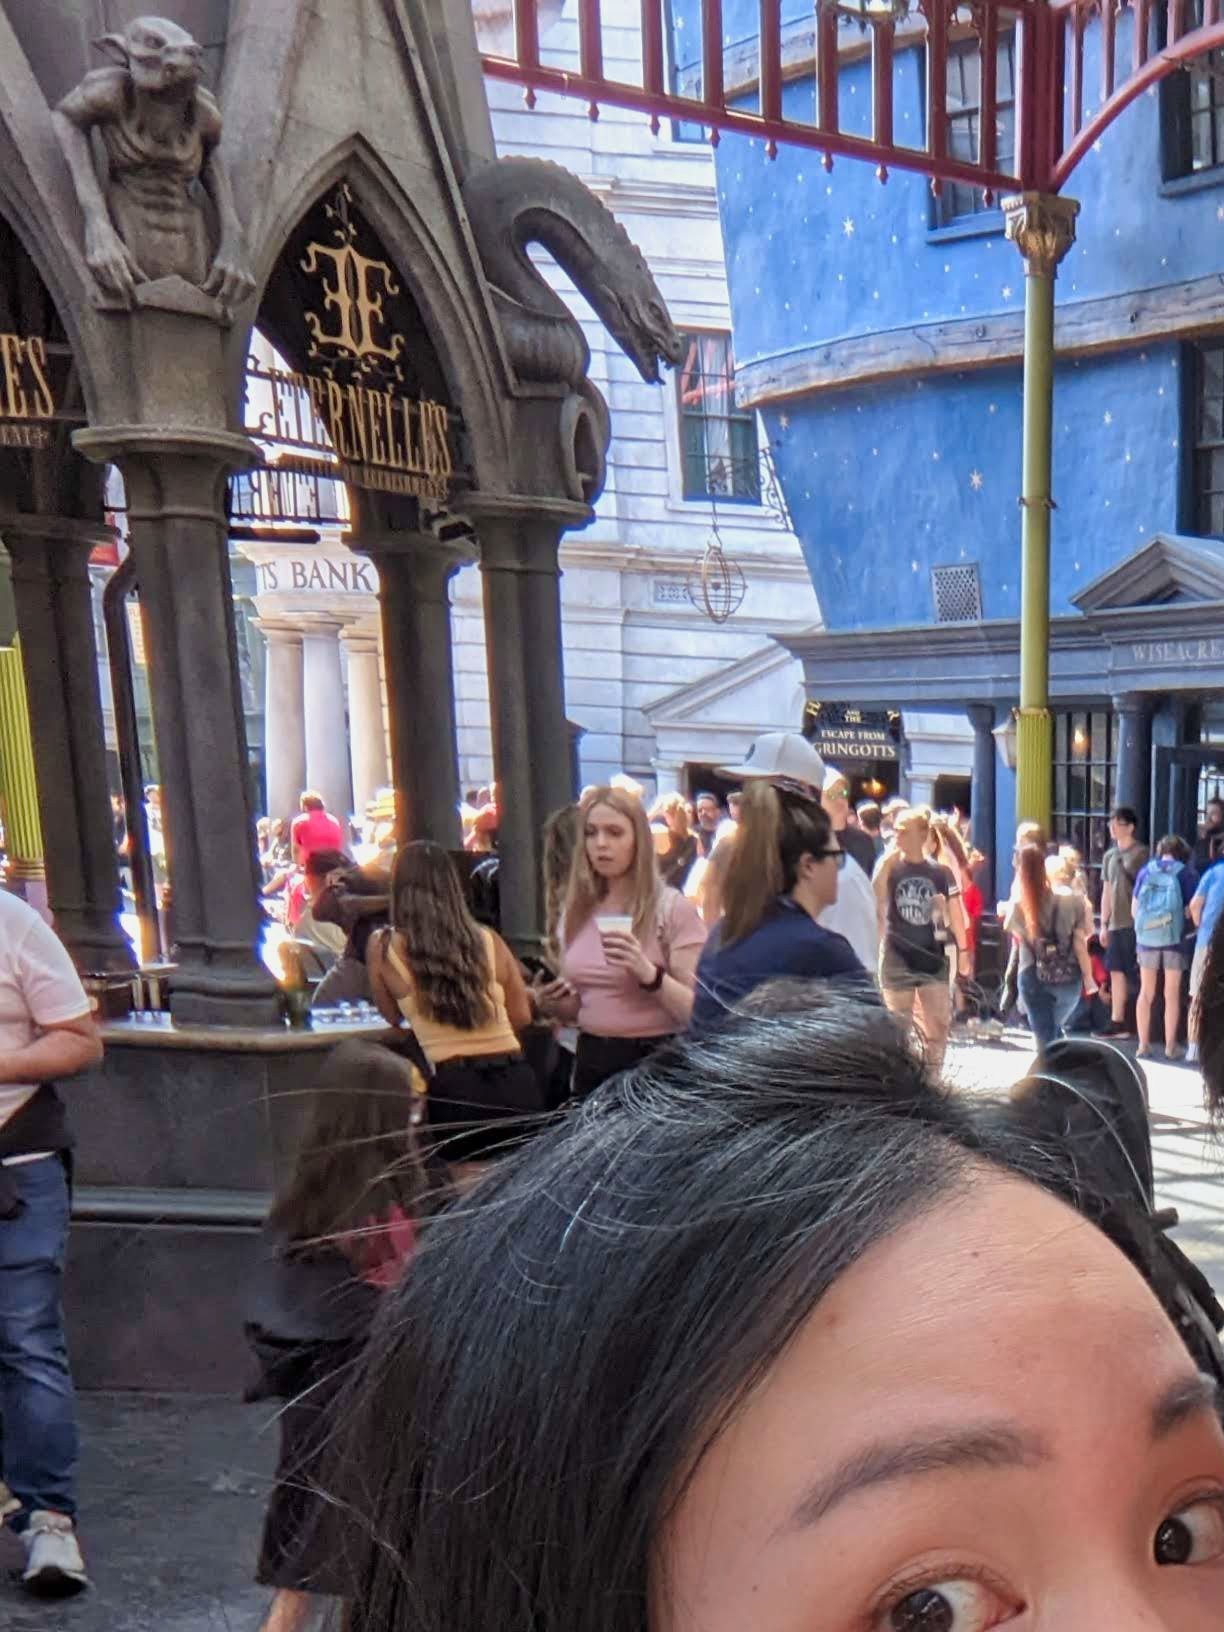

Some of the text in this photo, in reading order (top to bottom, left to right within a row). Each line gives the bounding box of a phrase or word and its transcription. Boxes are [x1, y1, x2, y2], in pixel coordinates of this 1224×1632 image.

[291, 559, 373, 592] BANK
[821, 730, 885, 741] ESCAPE FROM
